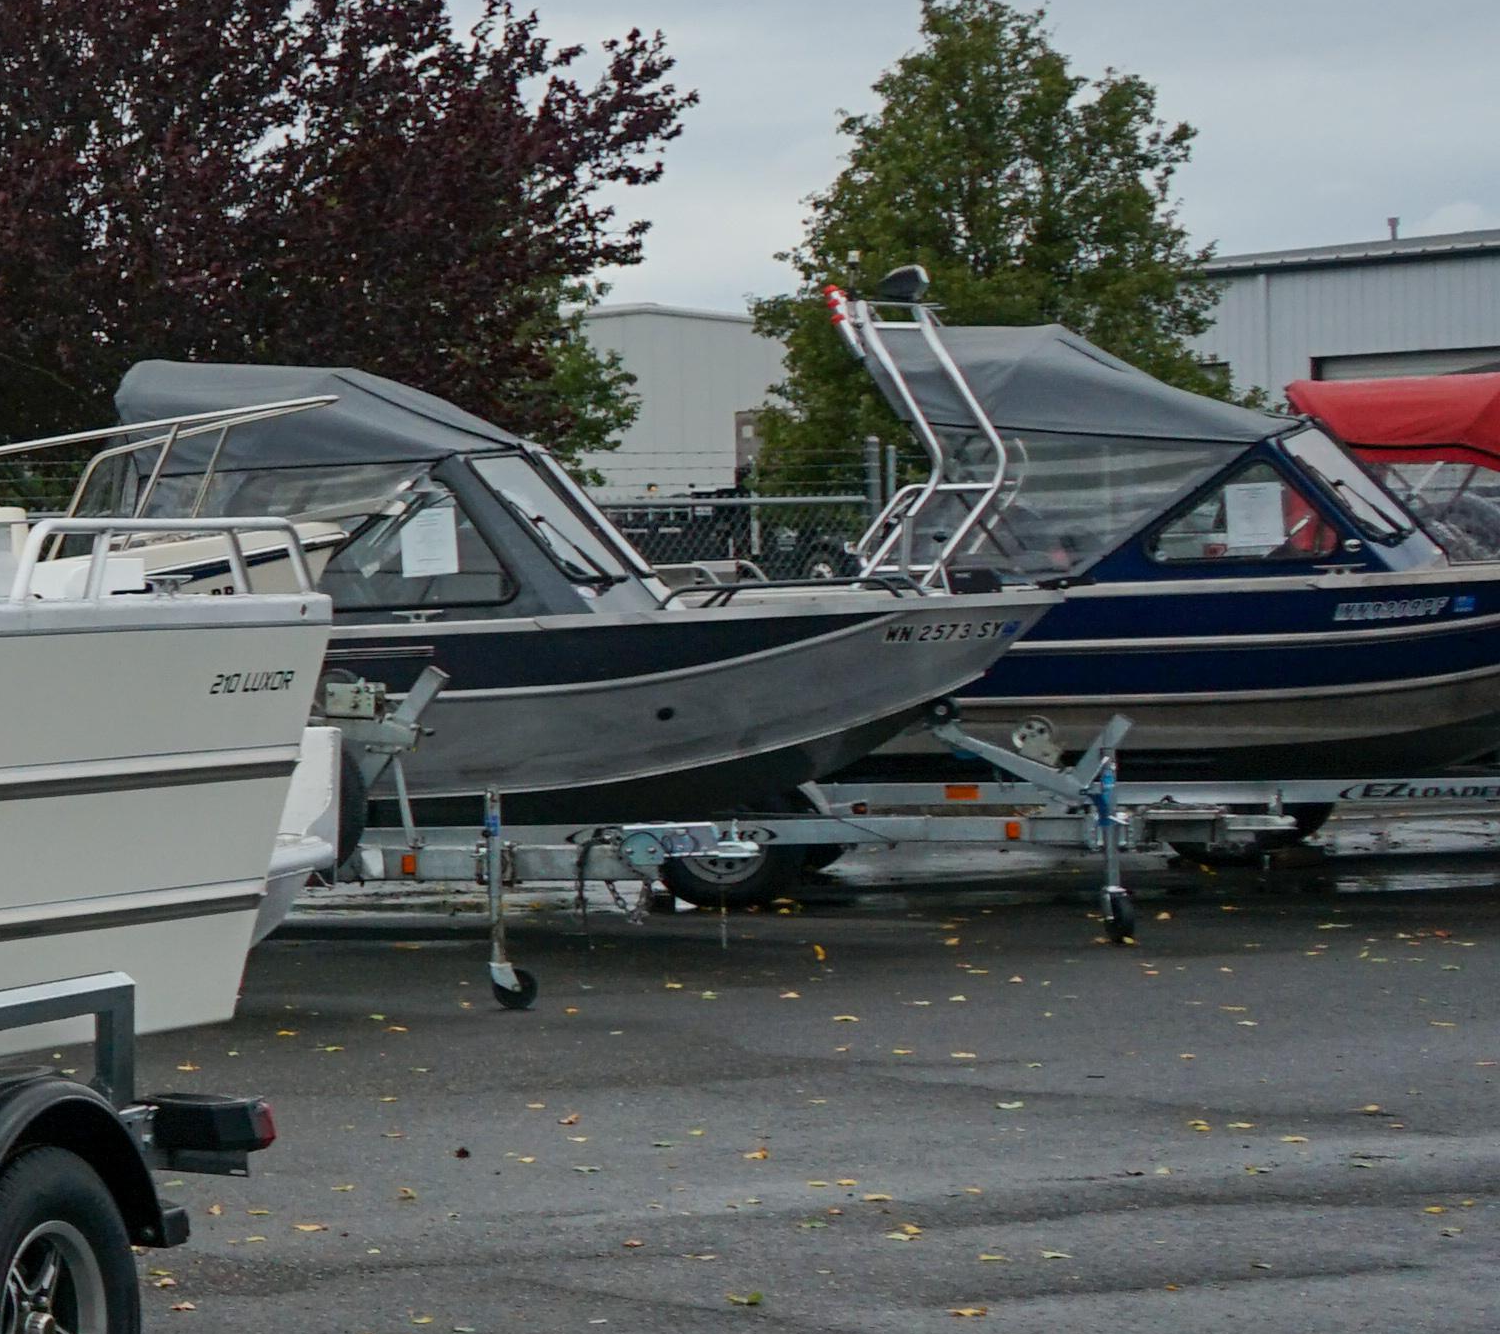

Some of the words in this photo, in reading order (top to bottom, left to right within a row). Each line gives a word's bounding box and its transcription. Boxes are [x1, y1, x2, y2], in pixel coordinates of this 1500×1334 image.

[885, 625, 914, 642] WN
[918, 623, 972, 641] 2573
[977, 620, 1004, 639] SY
[209, 673, 242, 695] 210
[242, 670, 295, 693] LUXOR
